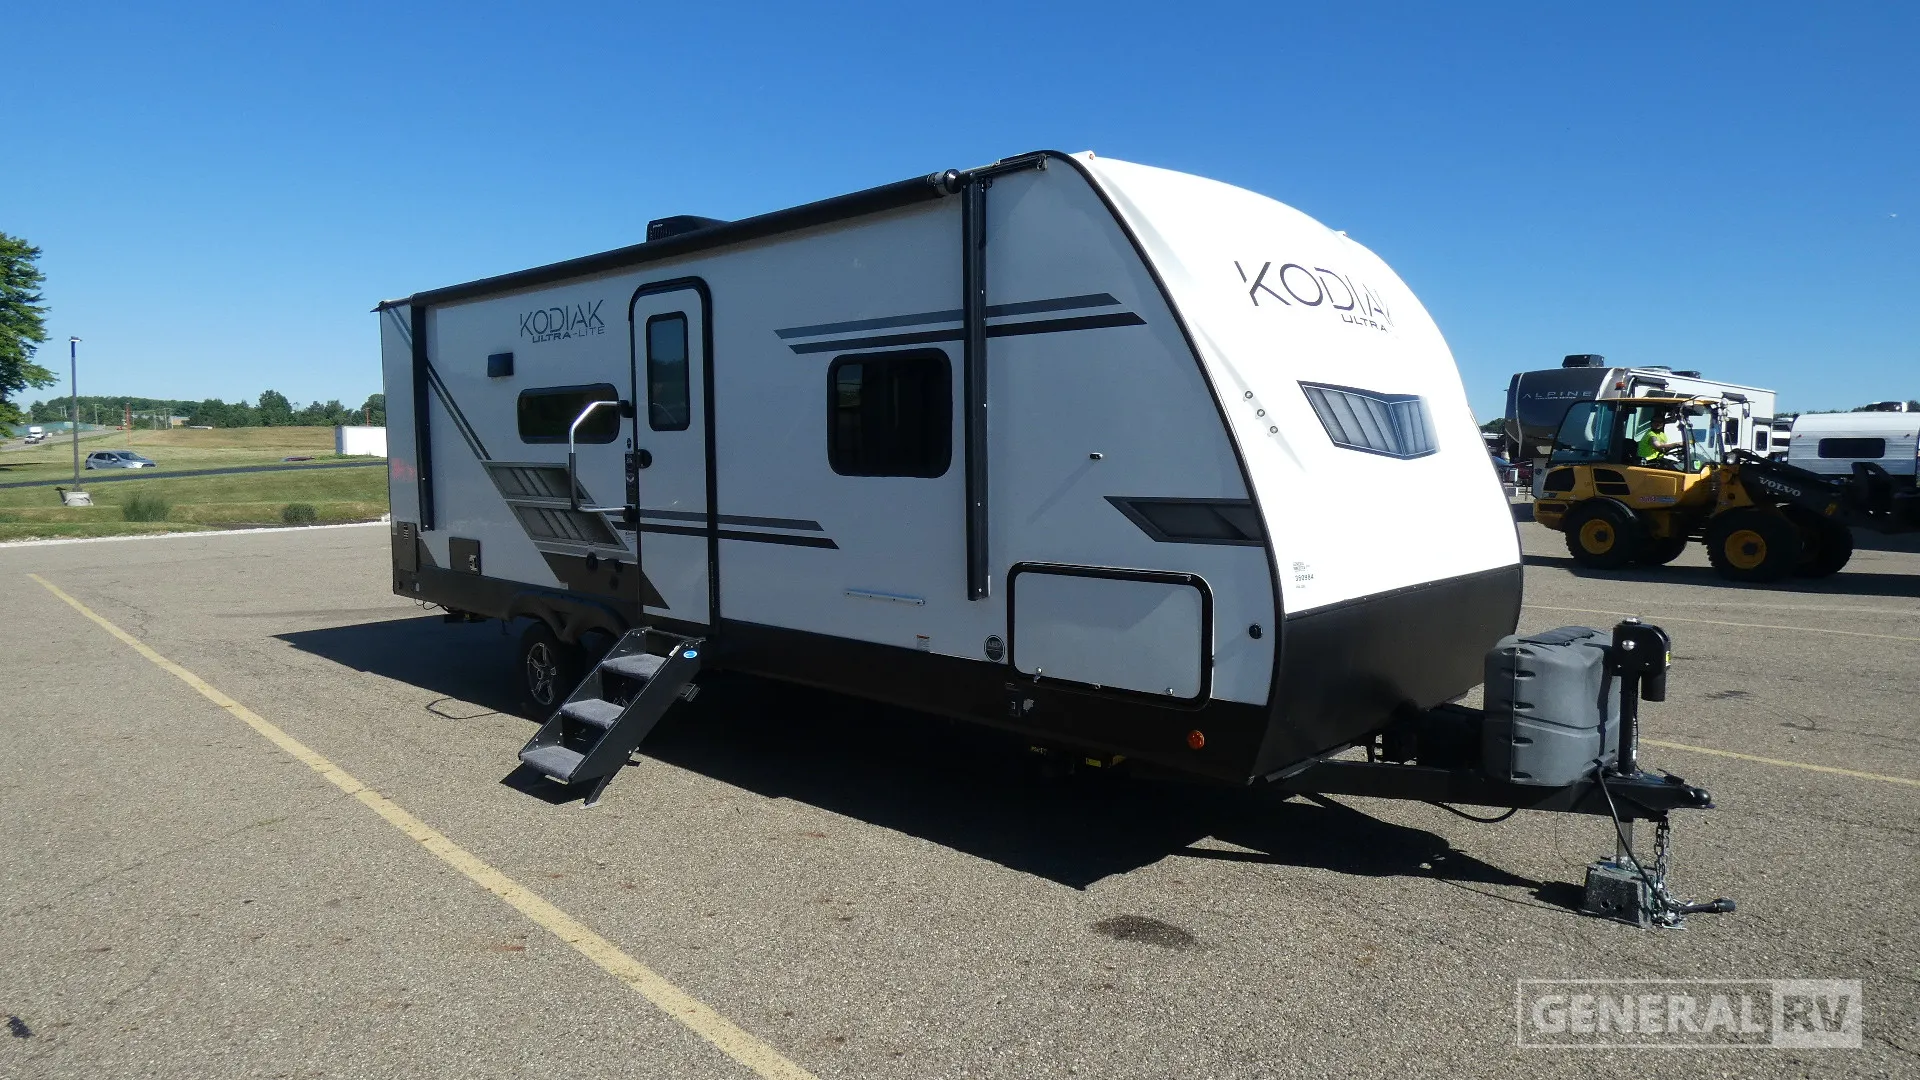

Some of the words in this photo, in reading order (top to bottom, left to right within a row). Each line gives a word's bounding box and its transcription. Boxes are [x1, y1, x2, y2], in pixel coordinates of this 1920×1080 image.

[520, 299, 605, 338] KODIAK
[532, 325, 605, 344] ULTRA-LITE
[1522, 390, 1593, 399] ALPINE
[1758, 476, 1801, 497] VOLVO
